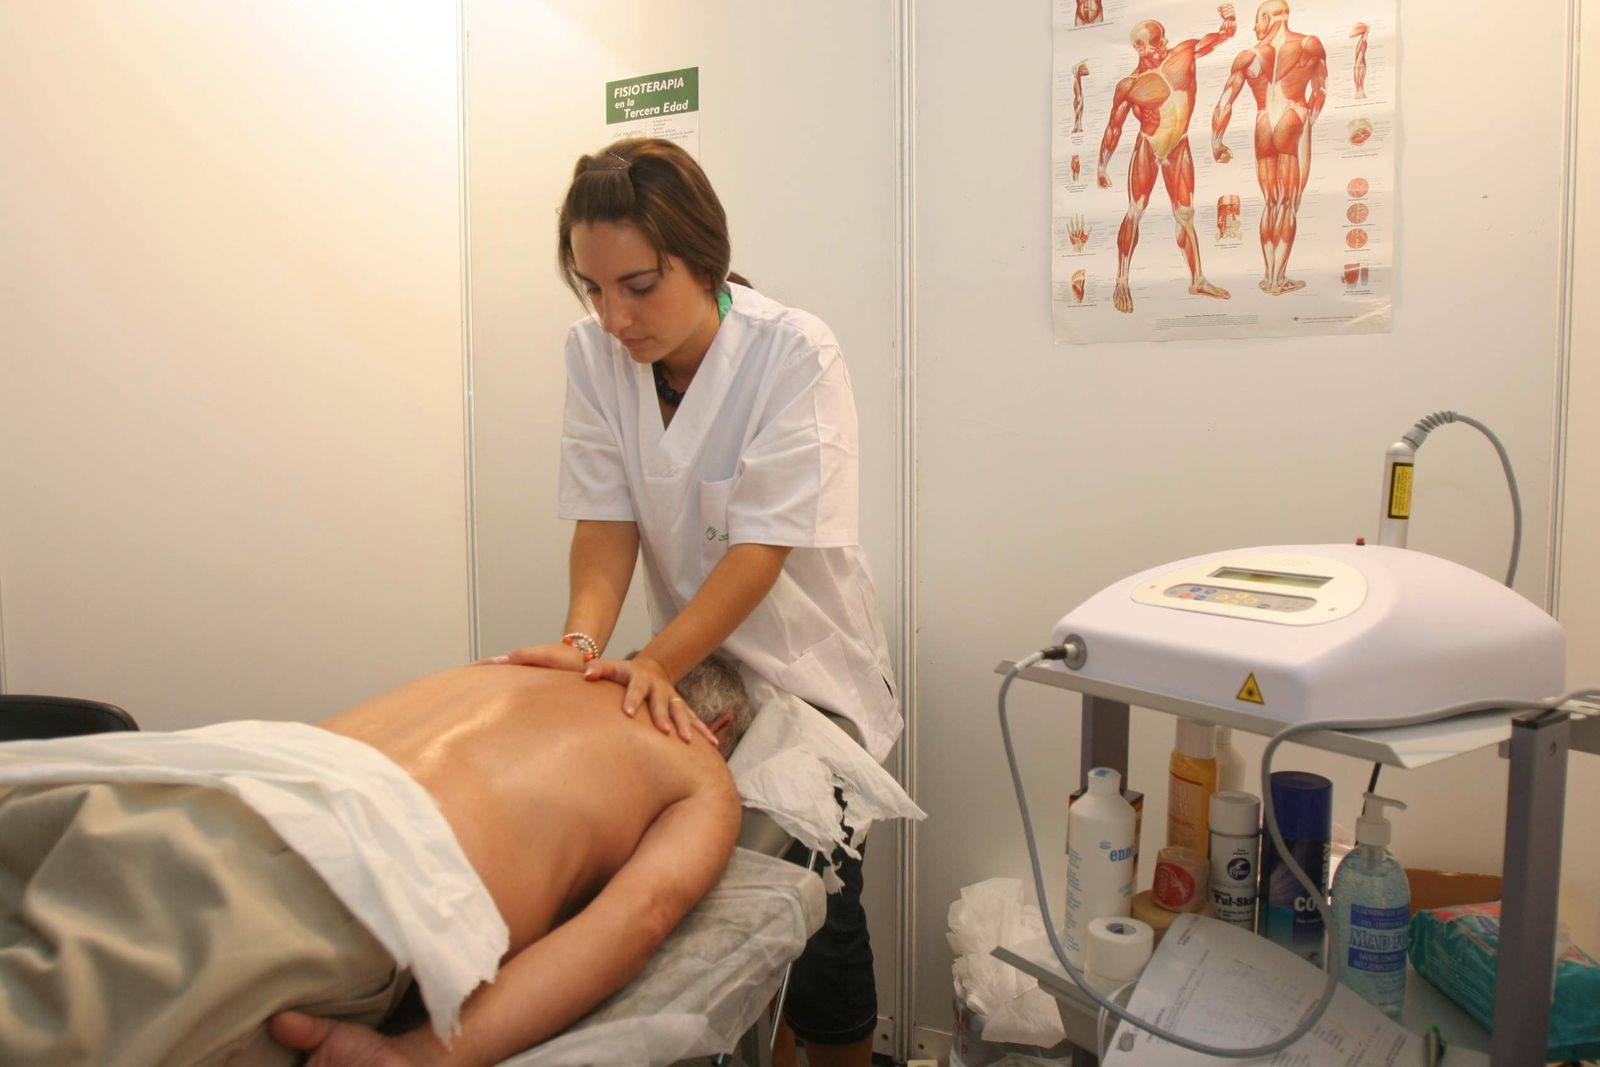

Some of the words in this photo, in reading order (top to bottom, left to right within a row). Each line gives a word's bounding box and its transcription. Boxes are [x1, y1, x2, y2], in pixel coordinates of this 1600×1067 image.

[614, 77, 684, 98] FISIOTERAPIA
[614, 101, 625, 109] en
[626, 98, 635, 107] la
[624, 105, 660, 119] Tercera
[663, 99, 689, 113] Edad
